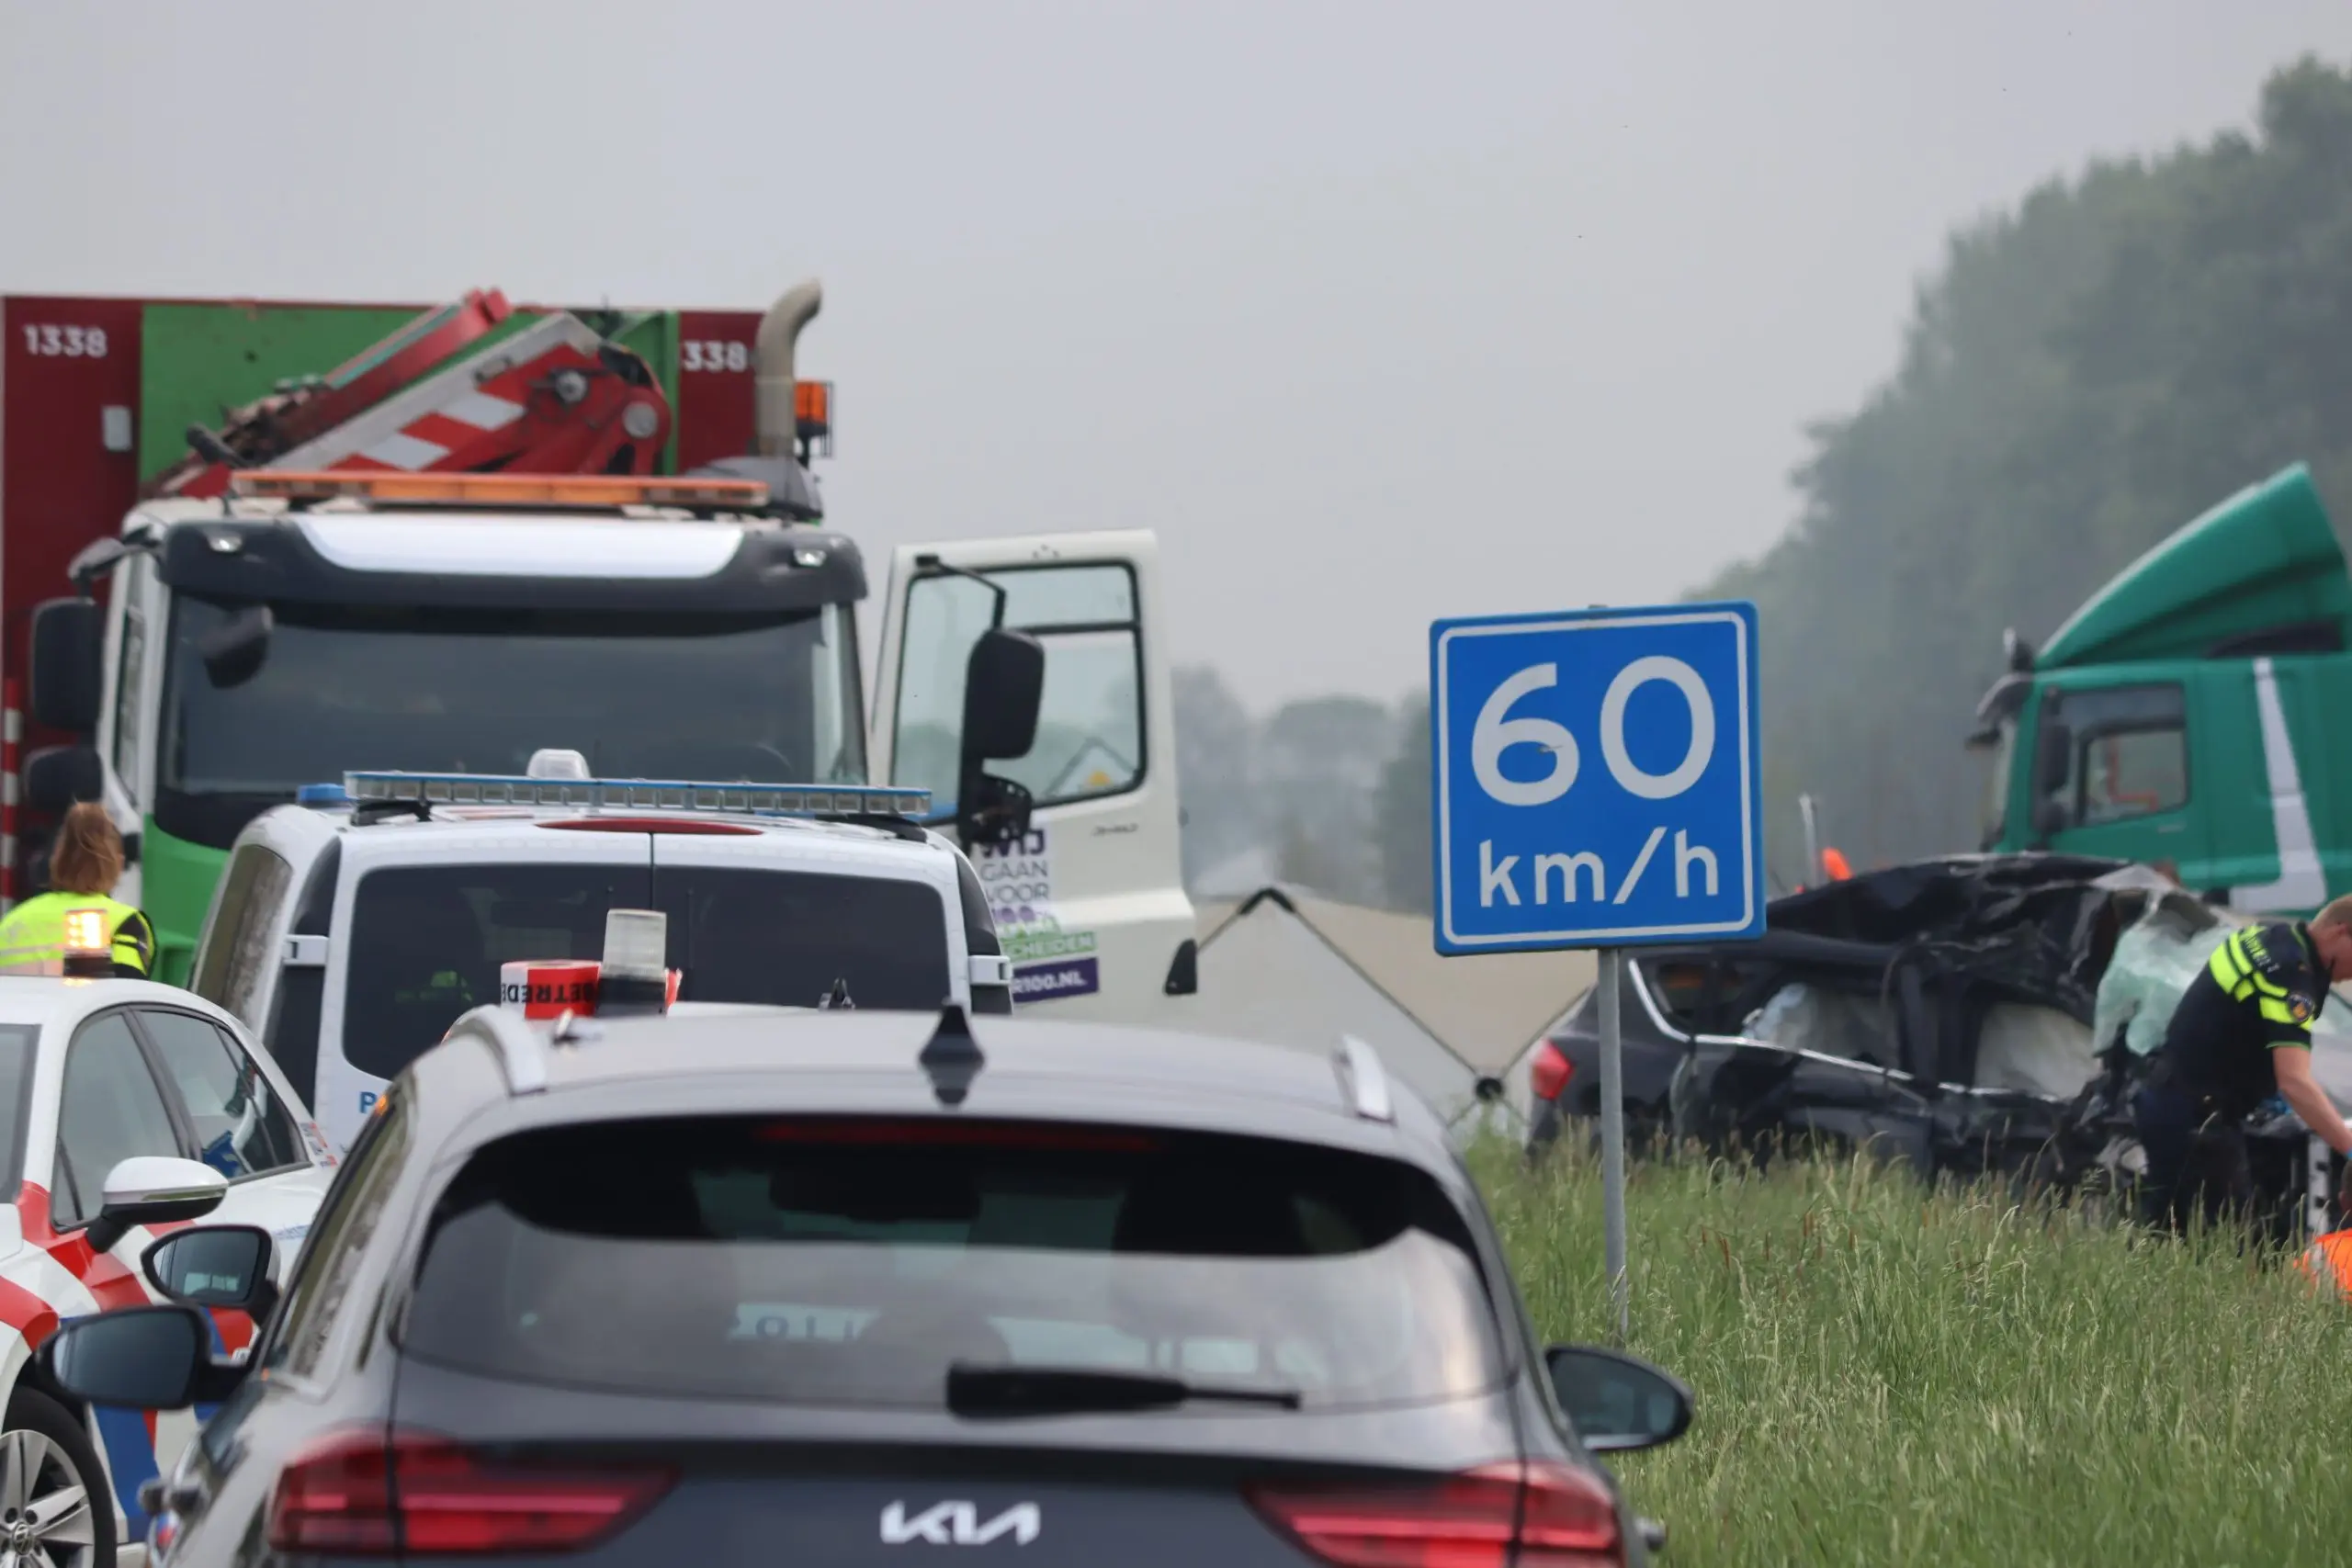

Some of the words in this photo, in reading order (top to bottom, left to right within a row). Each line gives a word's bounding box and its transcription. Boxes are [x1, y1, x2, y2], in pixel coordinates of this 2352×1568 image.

[24, 324, 107, 358] 1338
[1472, 656, 1715, 806] 60
[1479, 827, 1718, 908] km/h
[880, 1499, 1040, 1546] KIA
